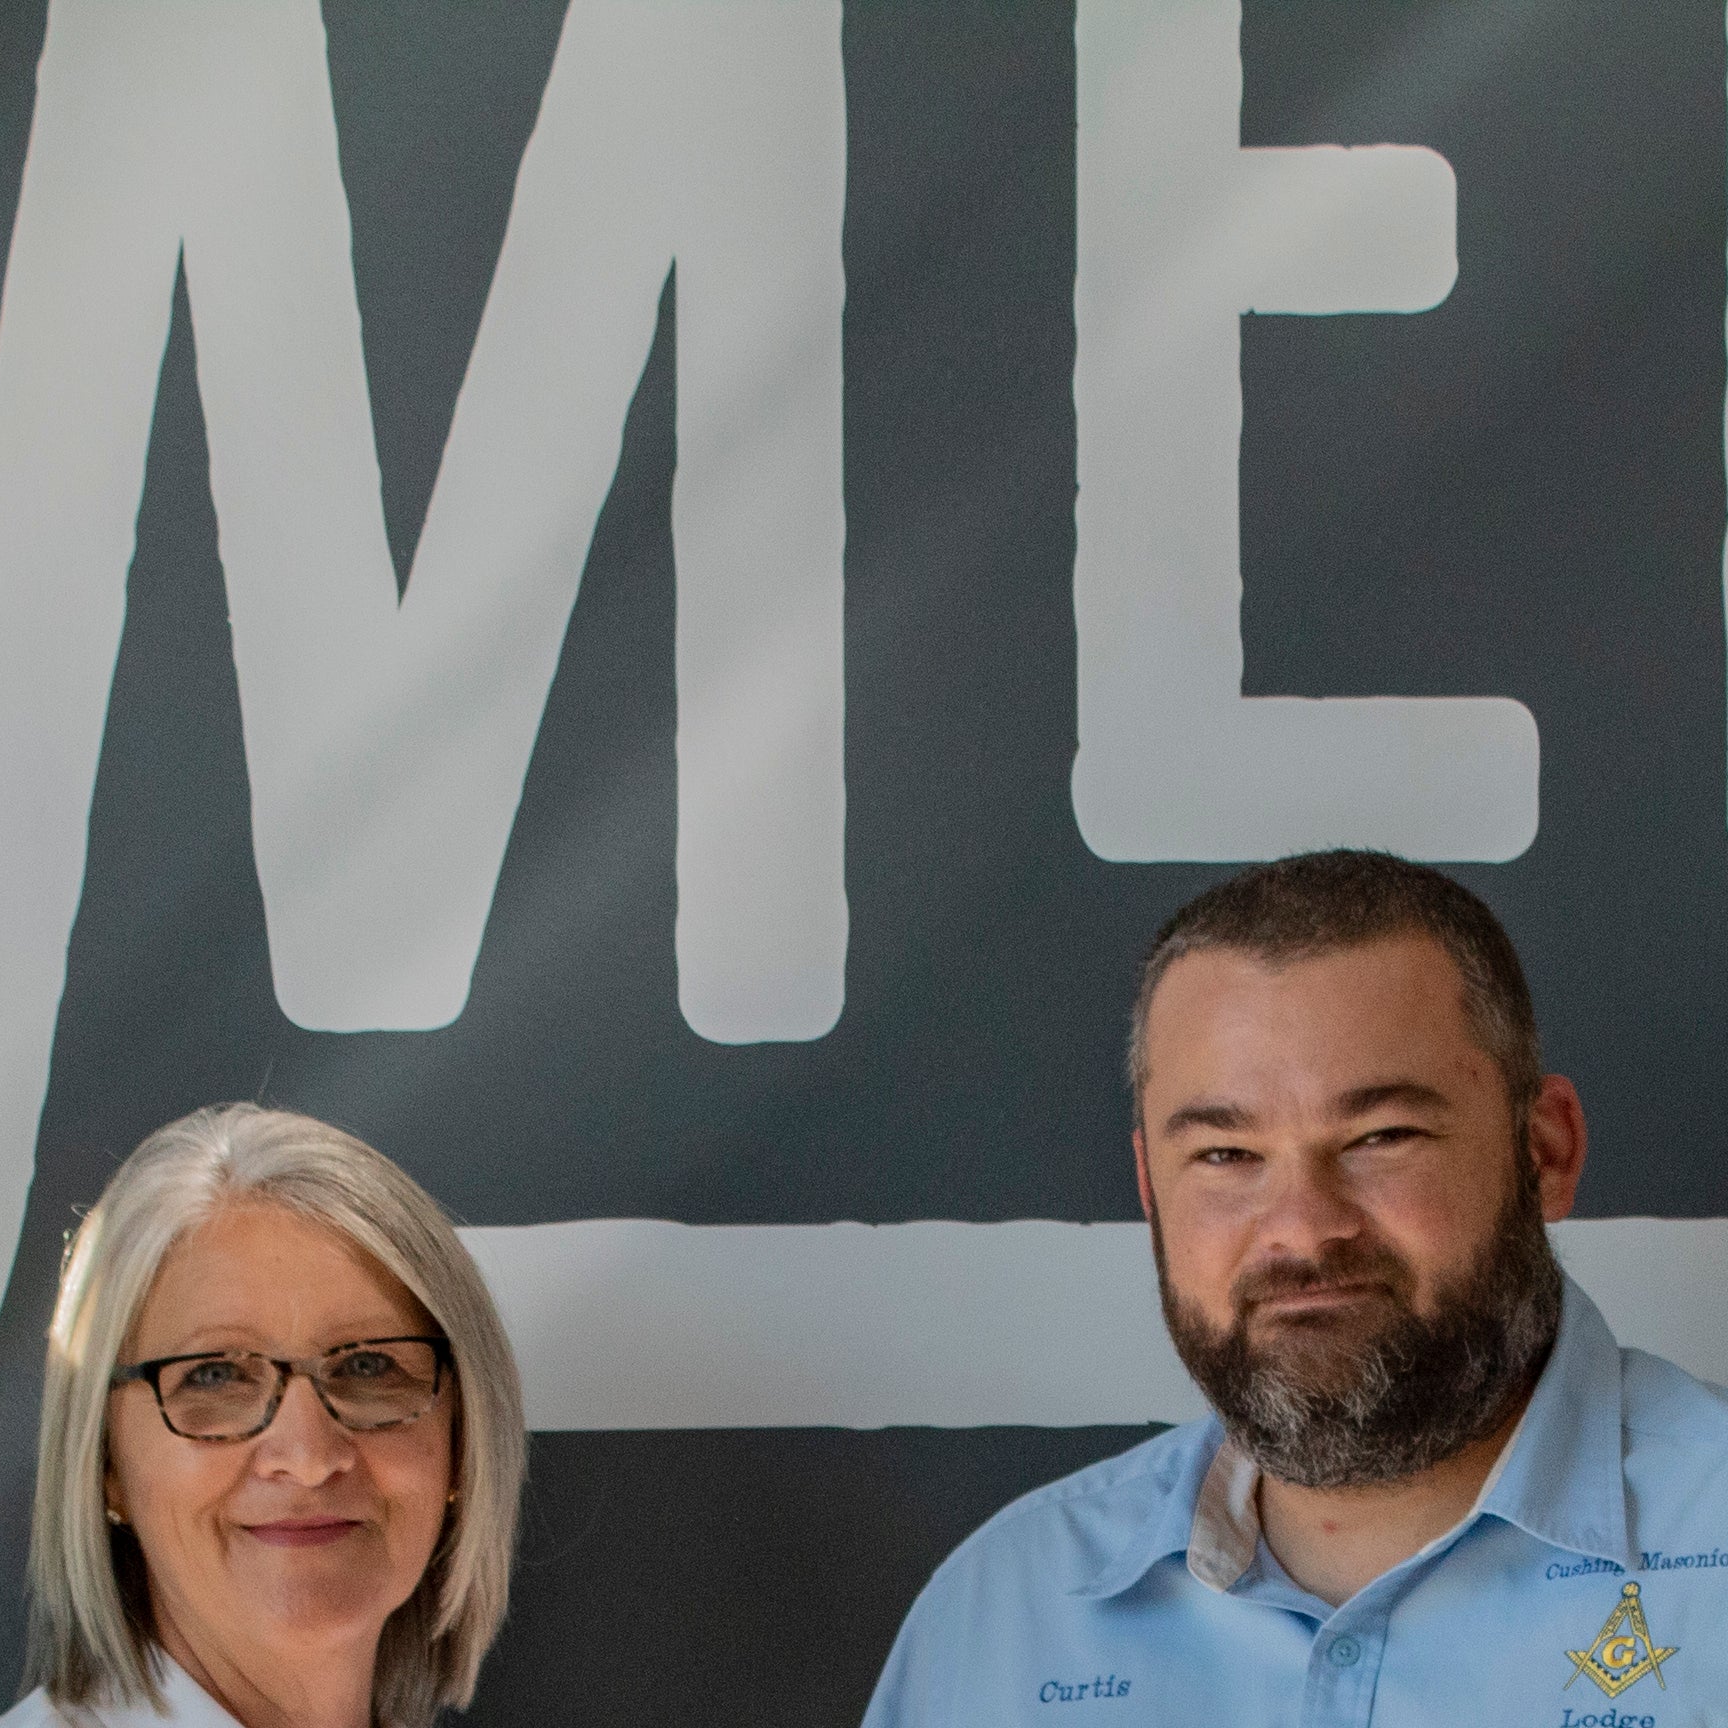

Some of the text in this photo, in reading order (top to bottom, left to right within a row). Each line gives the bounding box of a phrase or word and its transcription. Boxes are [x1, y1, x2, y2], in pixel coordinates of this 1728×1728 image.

[1545, 1557, 1626, 1581] Cushing
[1601, 1636, 1636, 1669] G
[1039, 1674, 1131, 1703] Curtis
